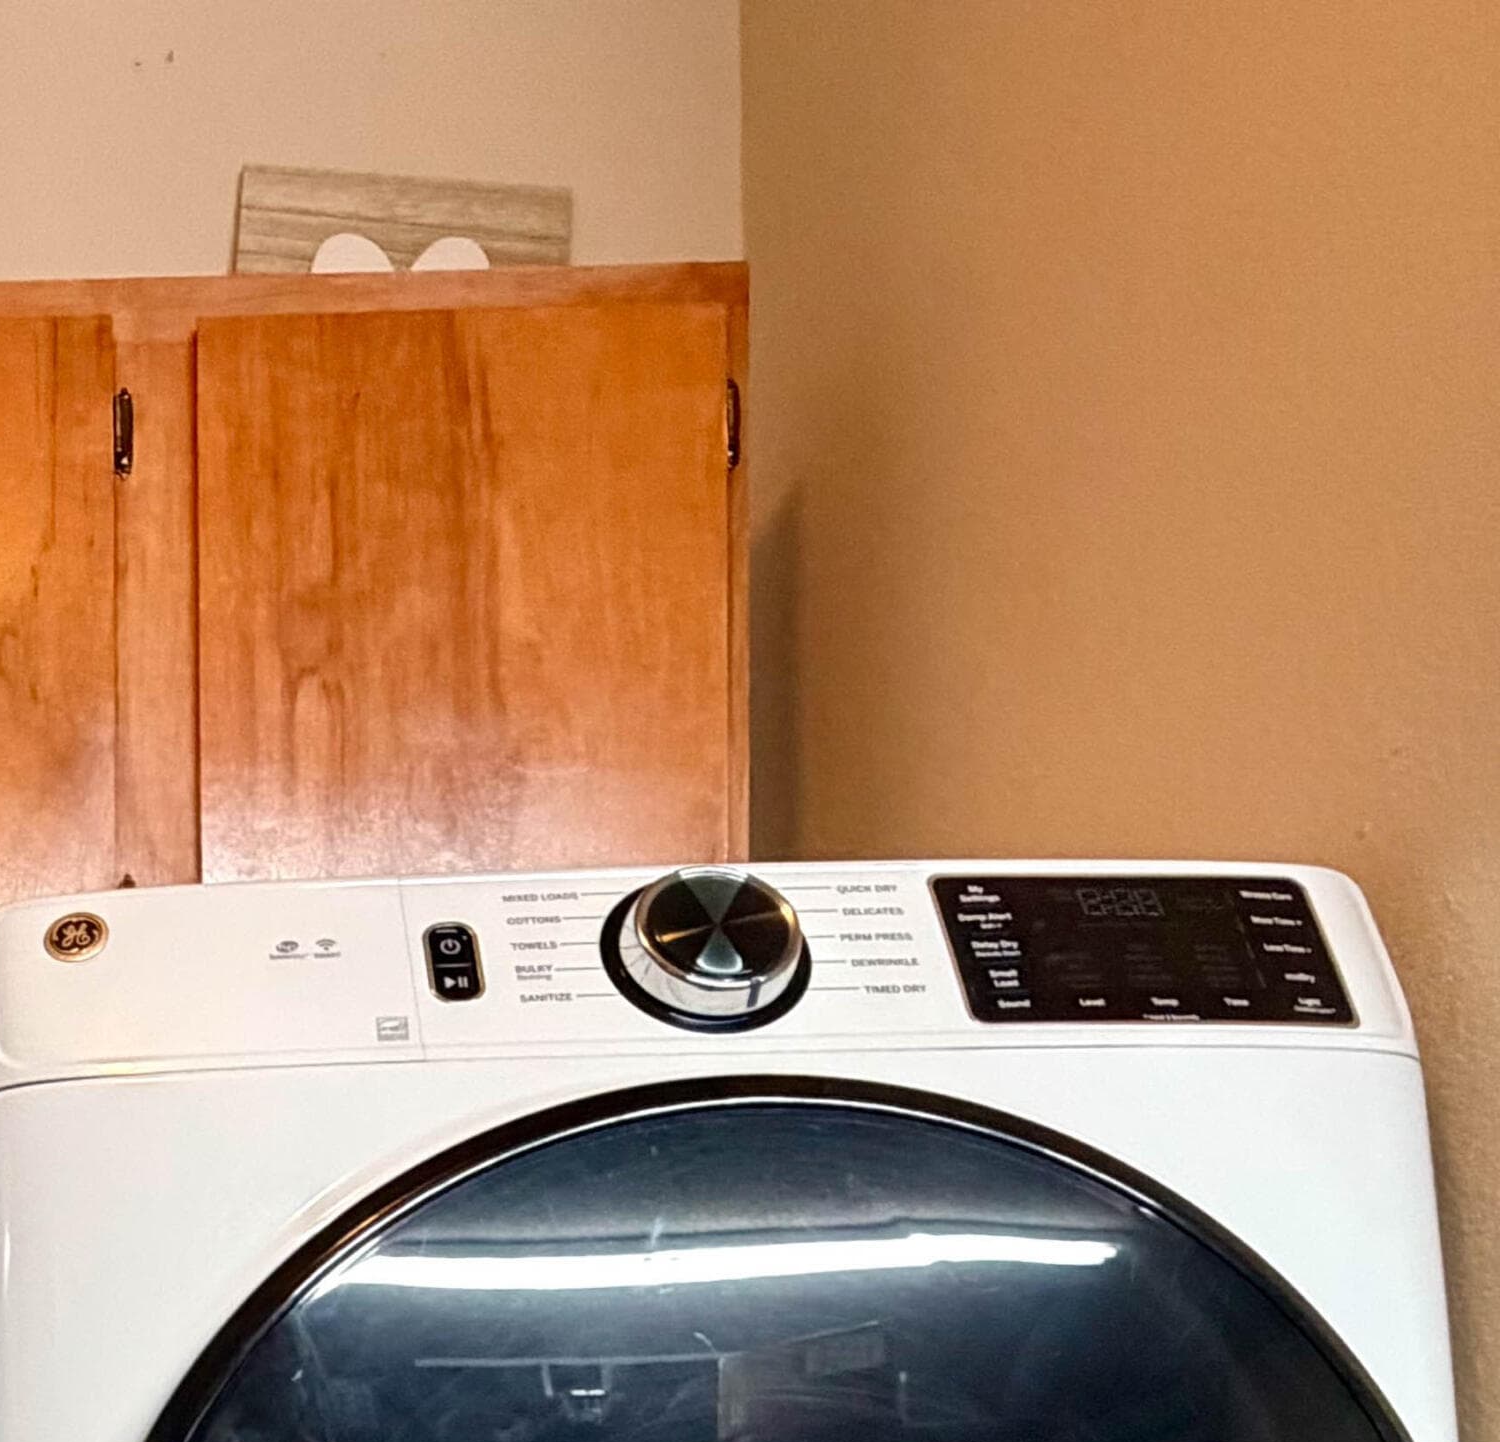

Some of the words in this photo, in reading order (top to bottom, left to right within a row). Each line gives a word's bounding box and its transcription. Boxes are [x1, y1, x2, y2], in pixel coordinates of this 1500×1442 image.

[836, 884, 872, 895] QUICK
[874, 884, 898, 893] DRY
[502, 893, 538, 903] MIXED
[541, 892, 579, 902] LOADS
[842, 907, 905, 916] DELICATES
[506, 916, 562, 926] COTTONS
[839, 932, 873, 942] PERM
[874, 932, 914, 942] PRESS
[510, 941, 559, 951] TOWELS
[851, 957, 920, 967] DEWRINKLE
[515, 964, 553, 974] BULKY
[863, 984, 901, 995] TIMED
[902, 984, 927, 993] DRY
[520, 993, 573, 1003] SANITIZE
